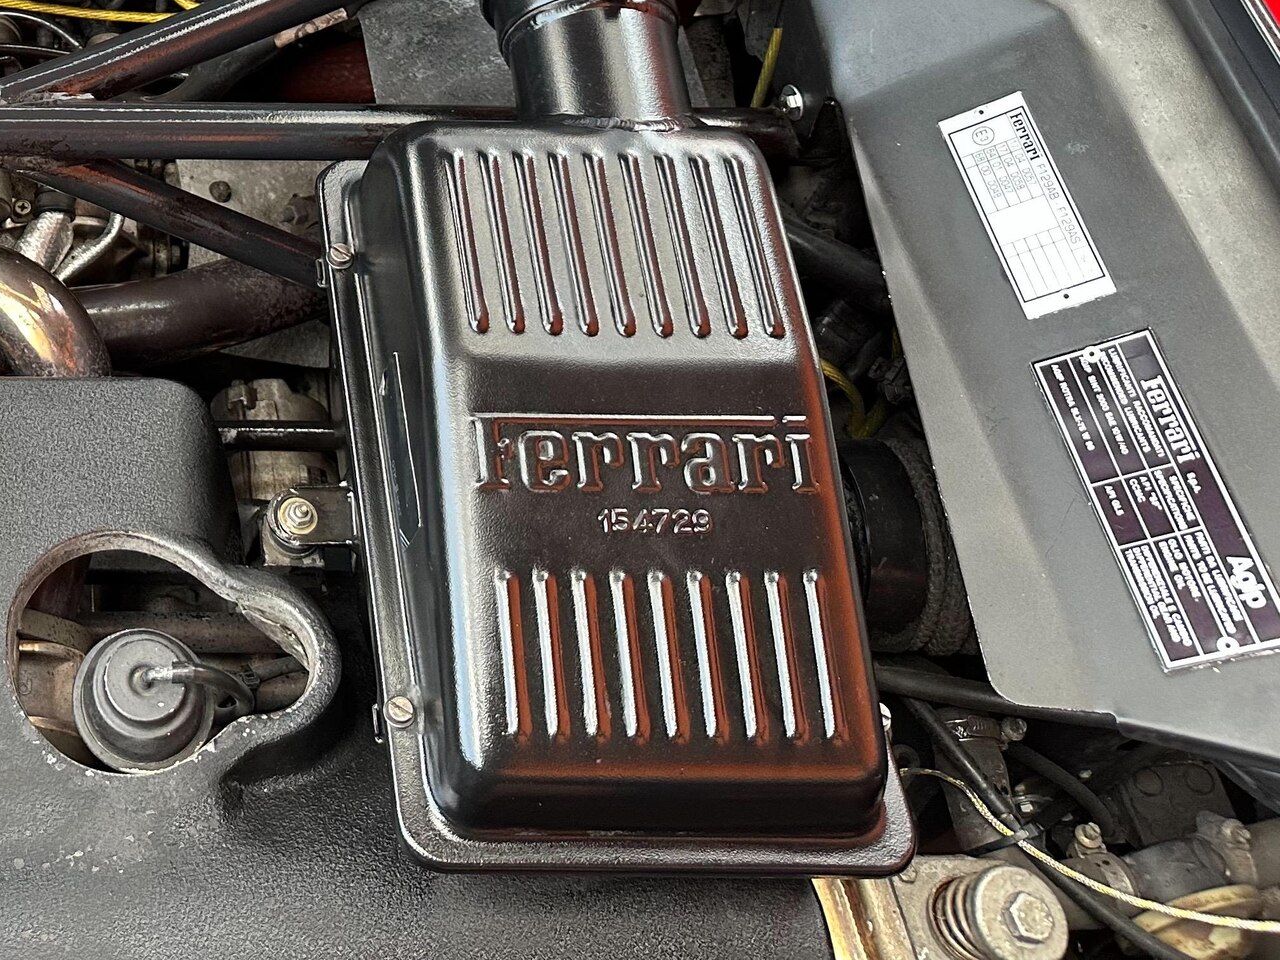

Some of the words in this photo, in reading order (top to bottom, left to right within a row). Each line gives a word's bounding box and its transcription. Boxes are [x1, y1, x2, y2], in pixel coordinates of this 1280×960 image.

[1009, 111, 1041, 161] Ferrari
[1123, 406, 1152, 454] LUBRICANTS
[1139, 374, 1201, 464] Ferrari
[469, 412, 821, 496] Ferrari
[596, 507, 714, 535] 154729
[1225, 556, 1267, 613] Agip
